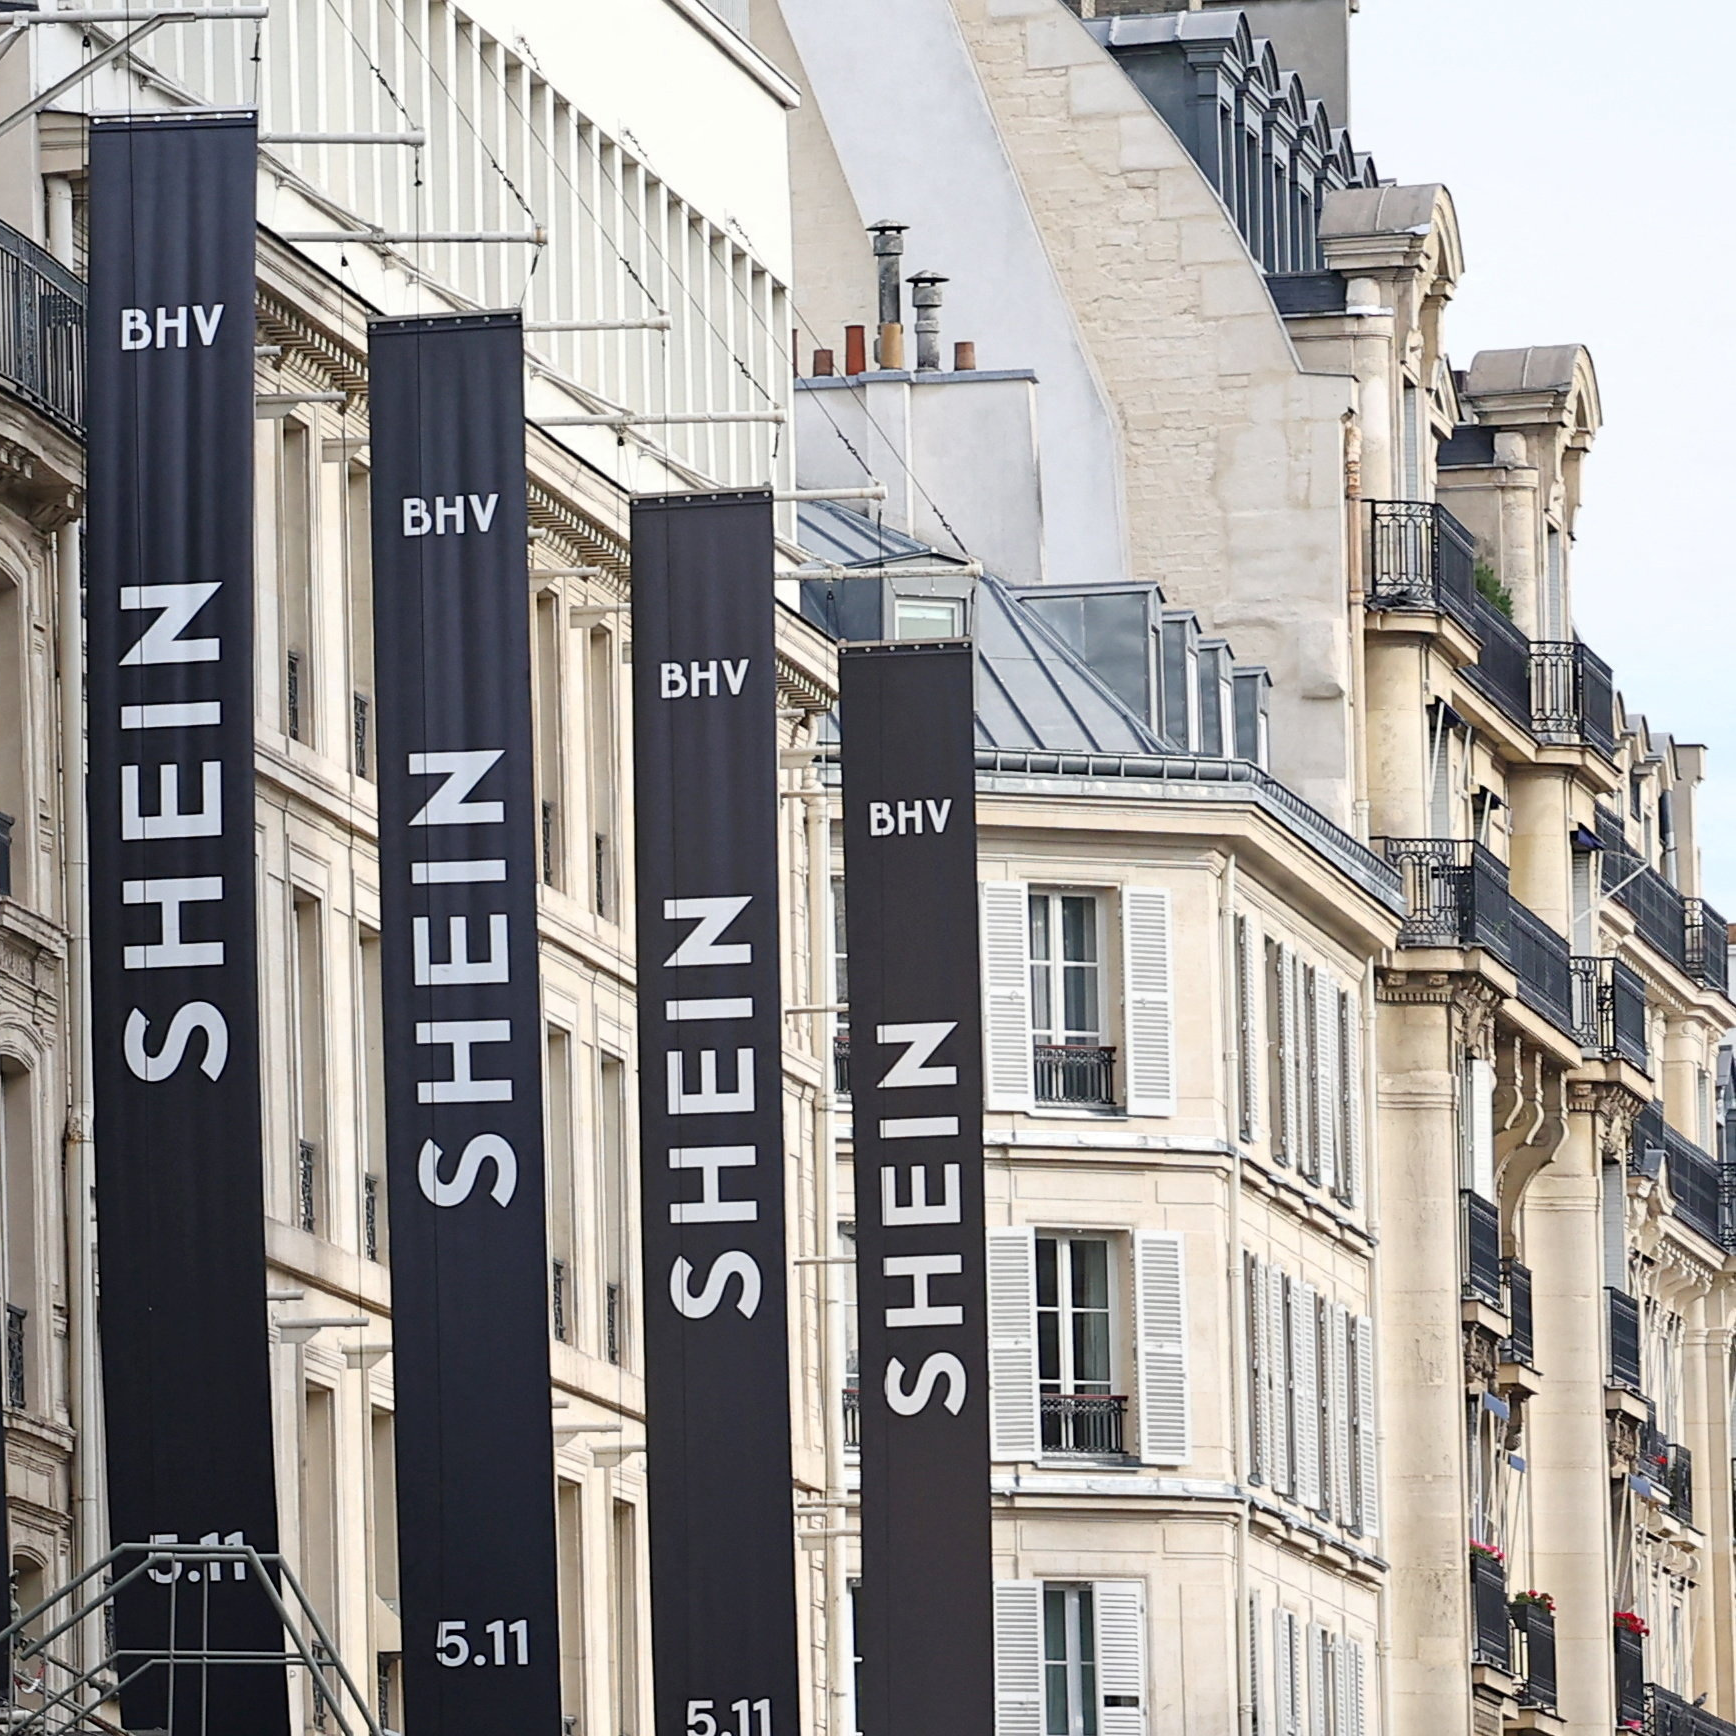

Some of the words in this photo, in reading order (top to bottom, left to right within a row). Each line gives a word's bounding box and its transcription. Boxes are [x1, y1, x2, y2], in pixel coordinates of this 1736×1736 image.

[122, 304, 223, 350] BHV
[404, 494, 498, 536] BHV
[661, 659, 749, 698] BHV
[119, 582, 227, 1081] SHEIN
[870, 799, 951, 835] BHV
[409, 750, 516, 1207] SHEIN
[664, 896, 760, 1318] SHEIN
[877, 1022, 966, 1415] SHEIN
[147, 1531, 246, 1584] 5.11
[437, 1620, 527, 1666] 5.11
